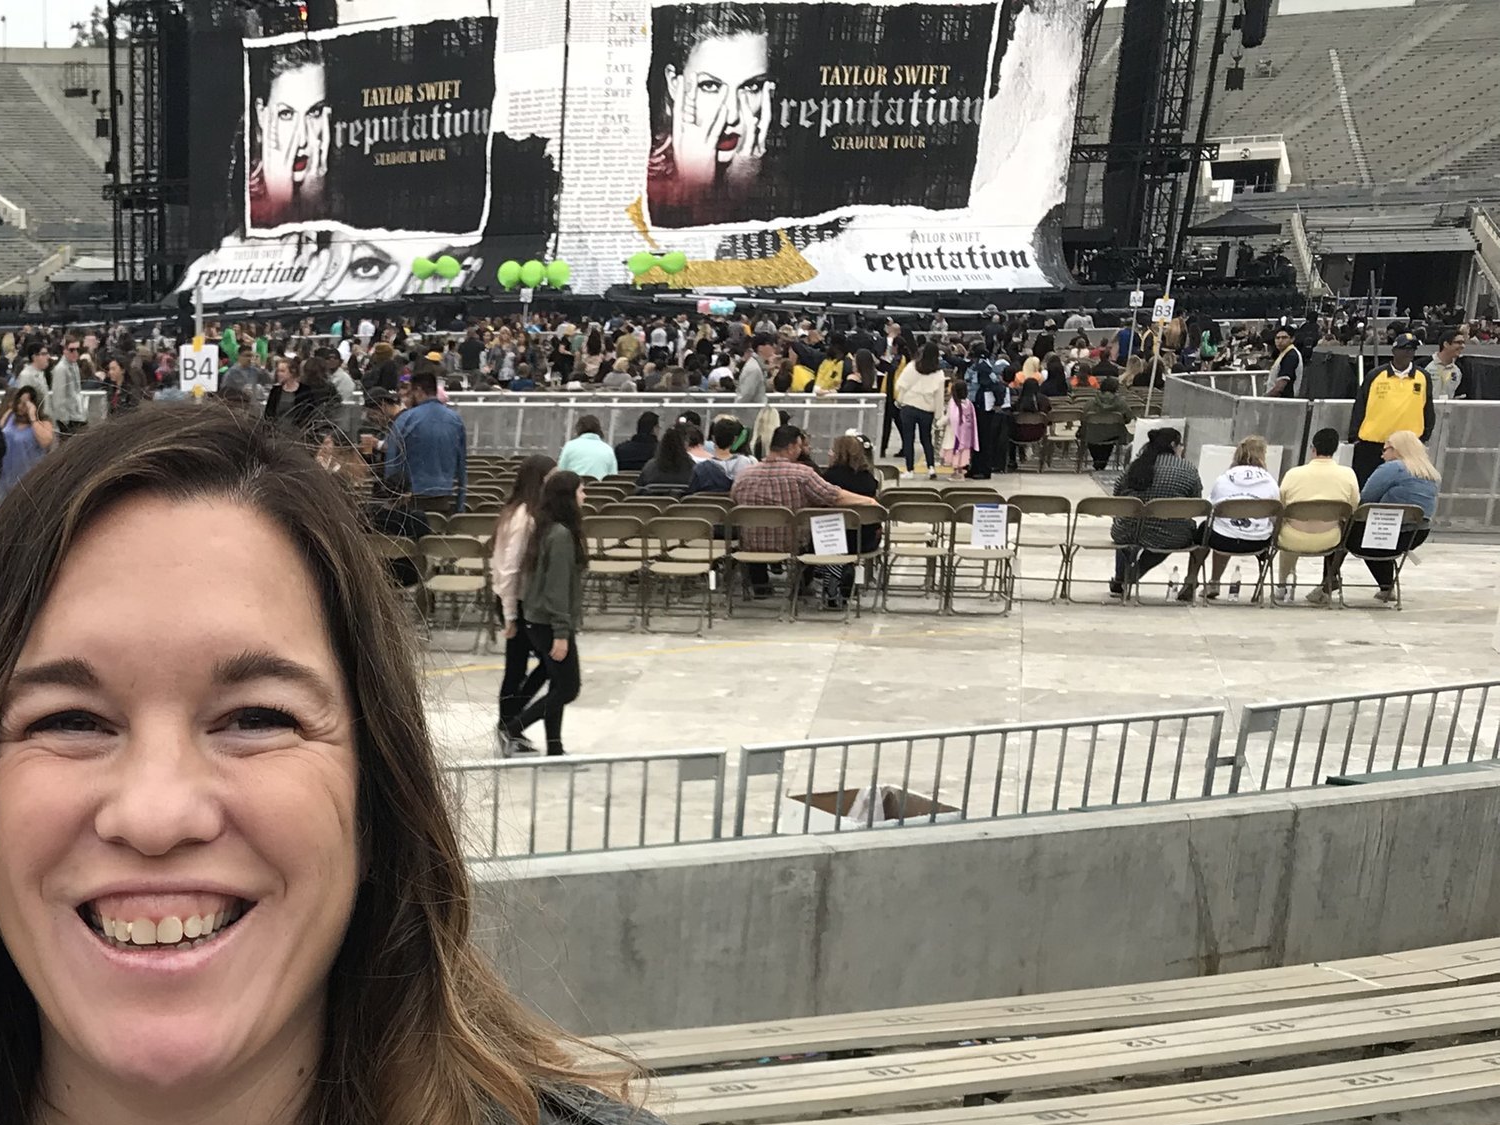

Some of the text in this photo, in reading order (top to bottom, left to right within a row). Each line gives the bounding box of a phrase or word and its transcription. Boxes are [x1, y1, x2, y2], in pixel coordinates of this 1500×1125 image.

[819, 65, 951, 86] TAYLOR SWIFT
[361, 80, 462, 108] TAYLOR SWIFT
[779, 87, 982, 139] reputation
[334, 102, 490, 156] reputation
[831, 134, 926, 150] STADIUM TOUR
[864, 245, 1030, 276] reputation
[197, 261, 309, 290] reputation
[1155, 304, 1172, 317] B3
[183, 357, 213, 381] B4
